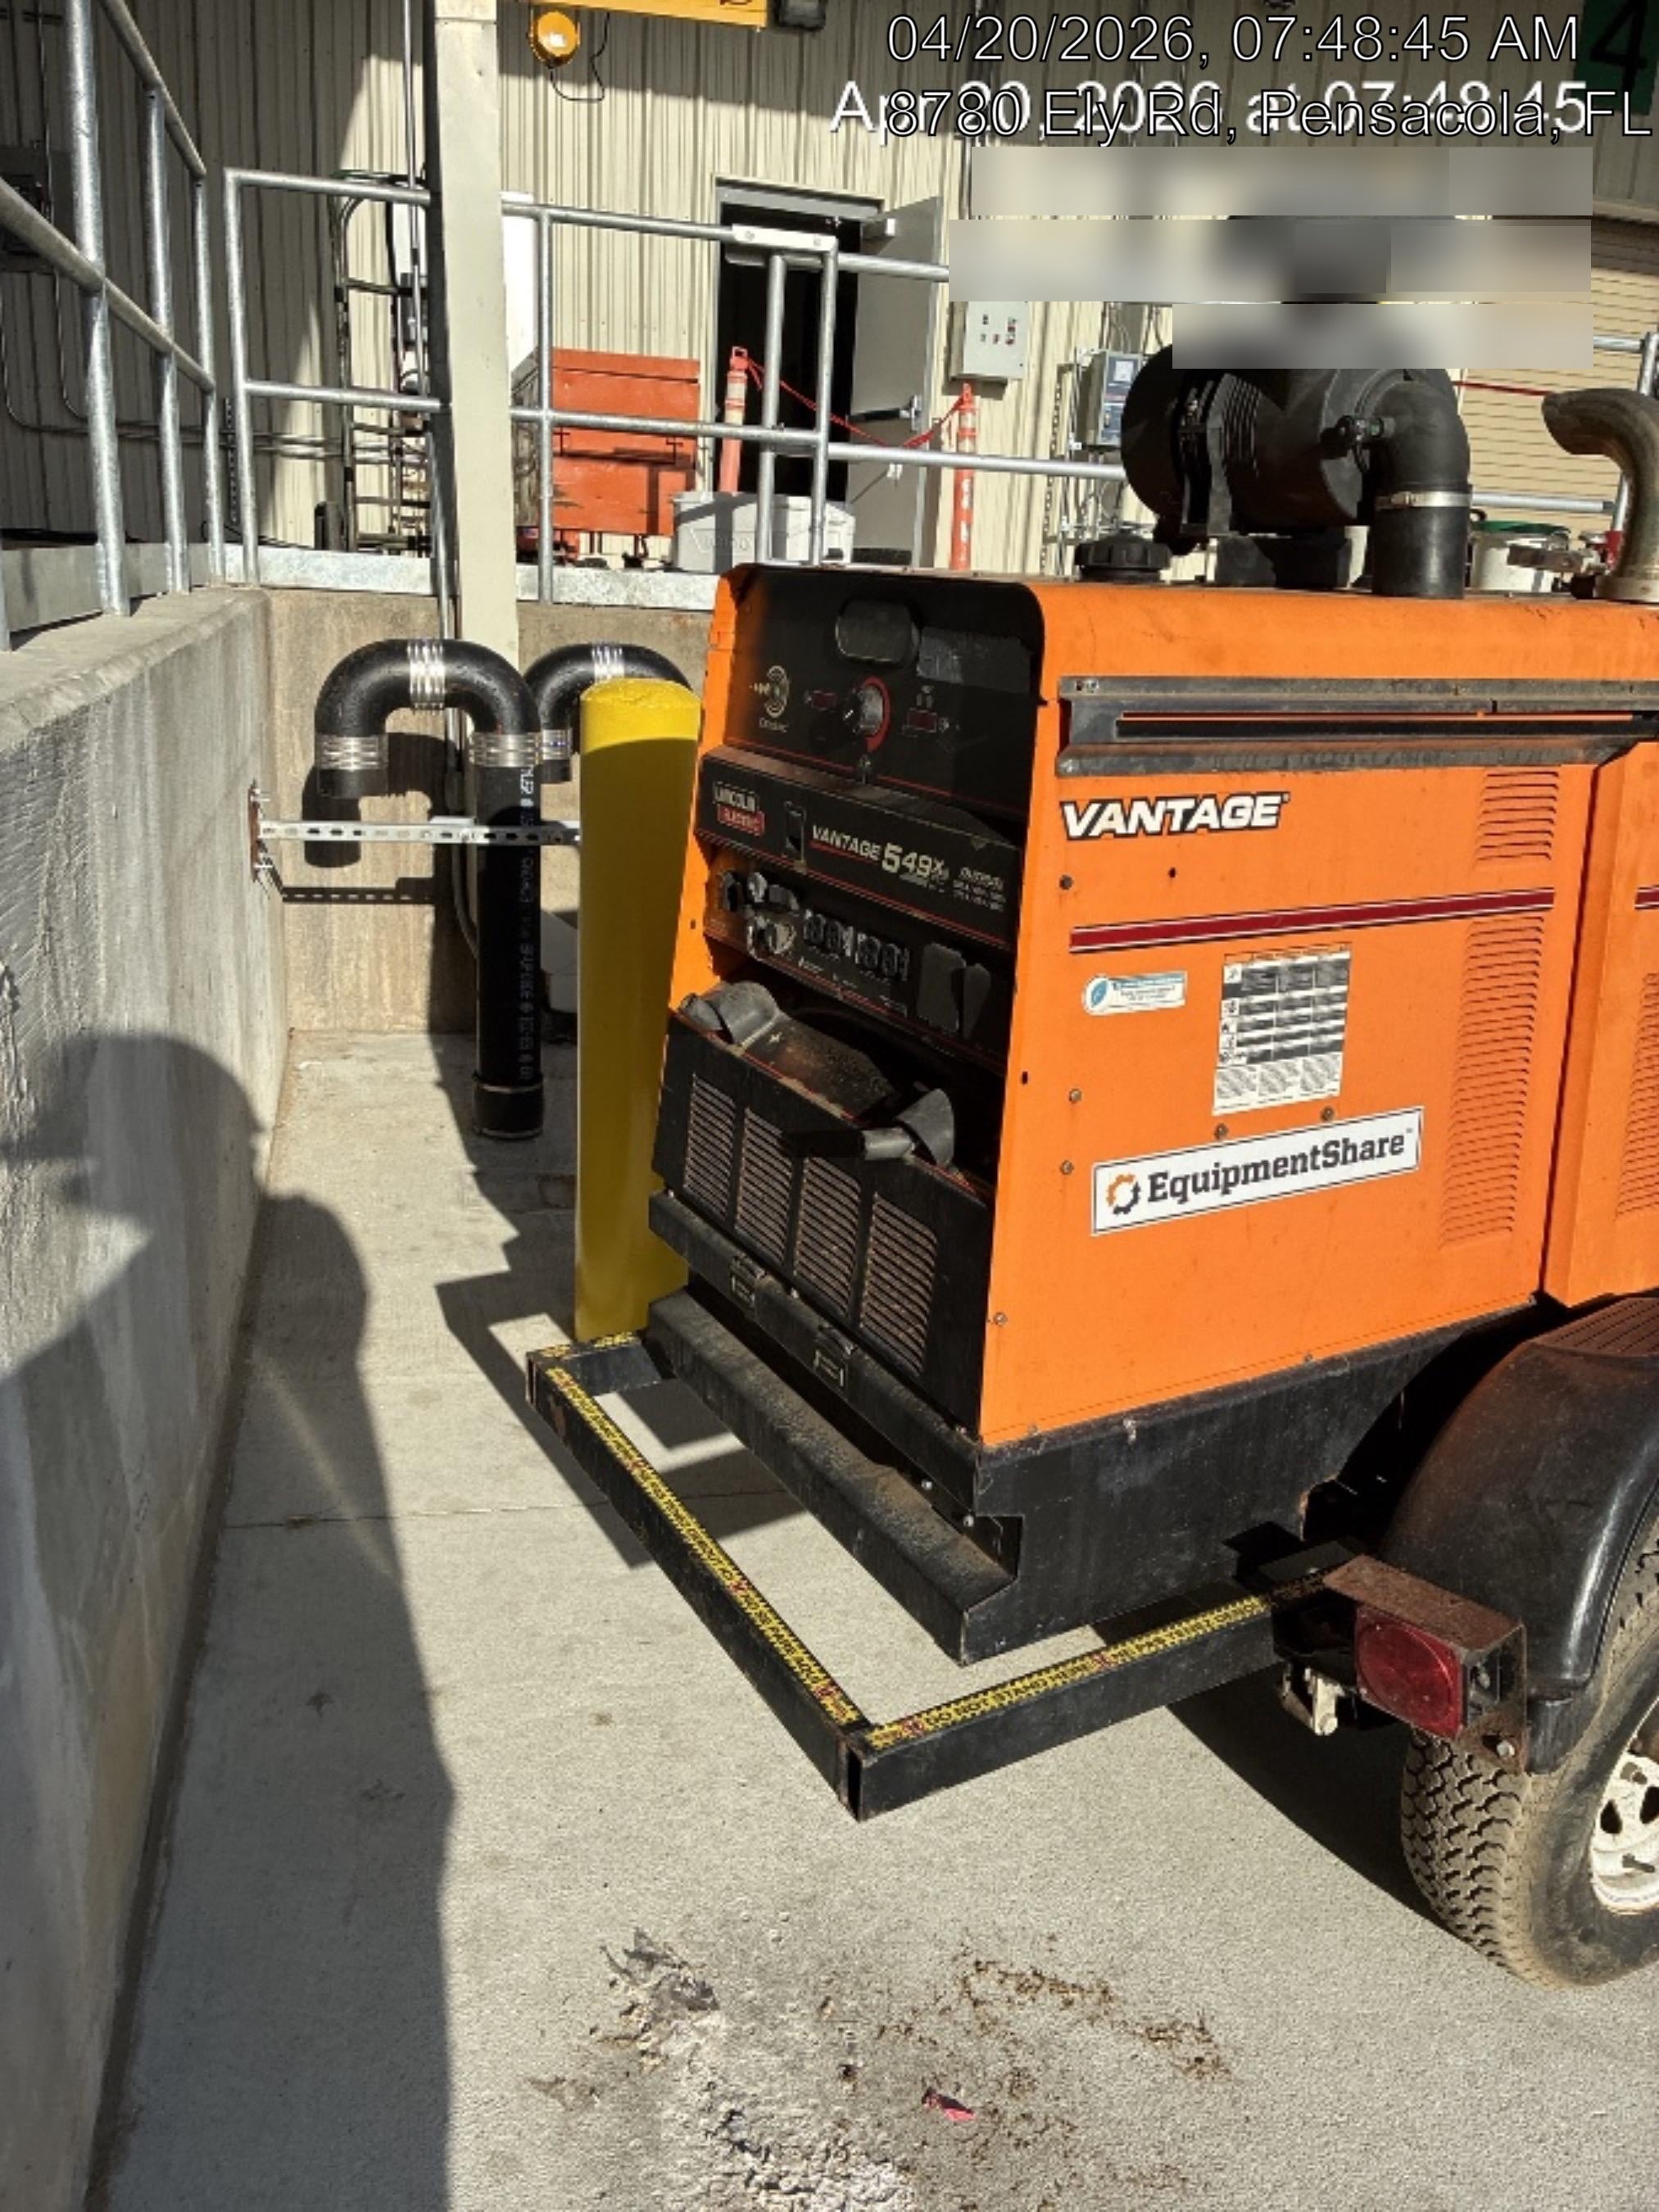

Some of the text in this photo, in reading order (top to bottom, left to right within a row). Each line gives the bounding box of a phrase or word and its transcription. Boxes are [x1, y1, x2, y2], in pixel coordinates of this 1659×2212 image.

[1060, 792, 1283, 841] VANTAGE
[811, 824, 882, 862] VANTAGE
[1147, 1135, 1405, 1204] EquipmentShare
